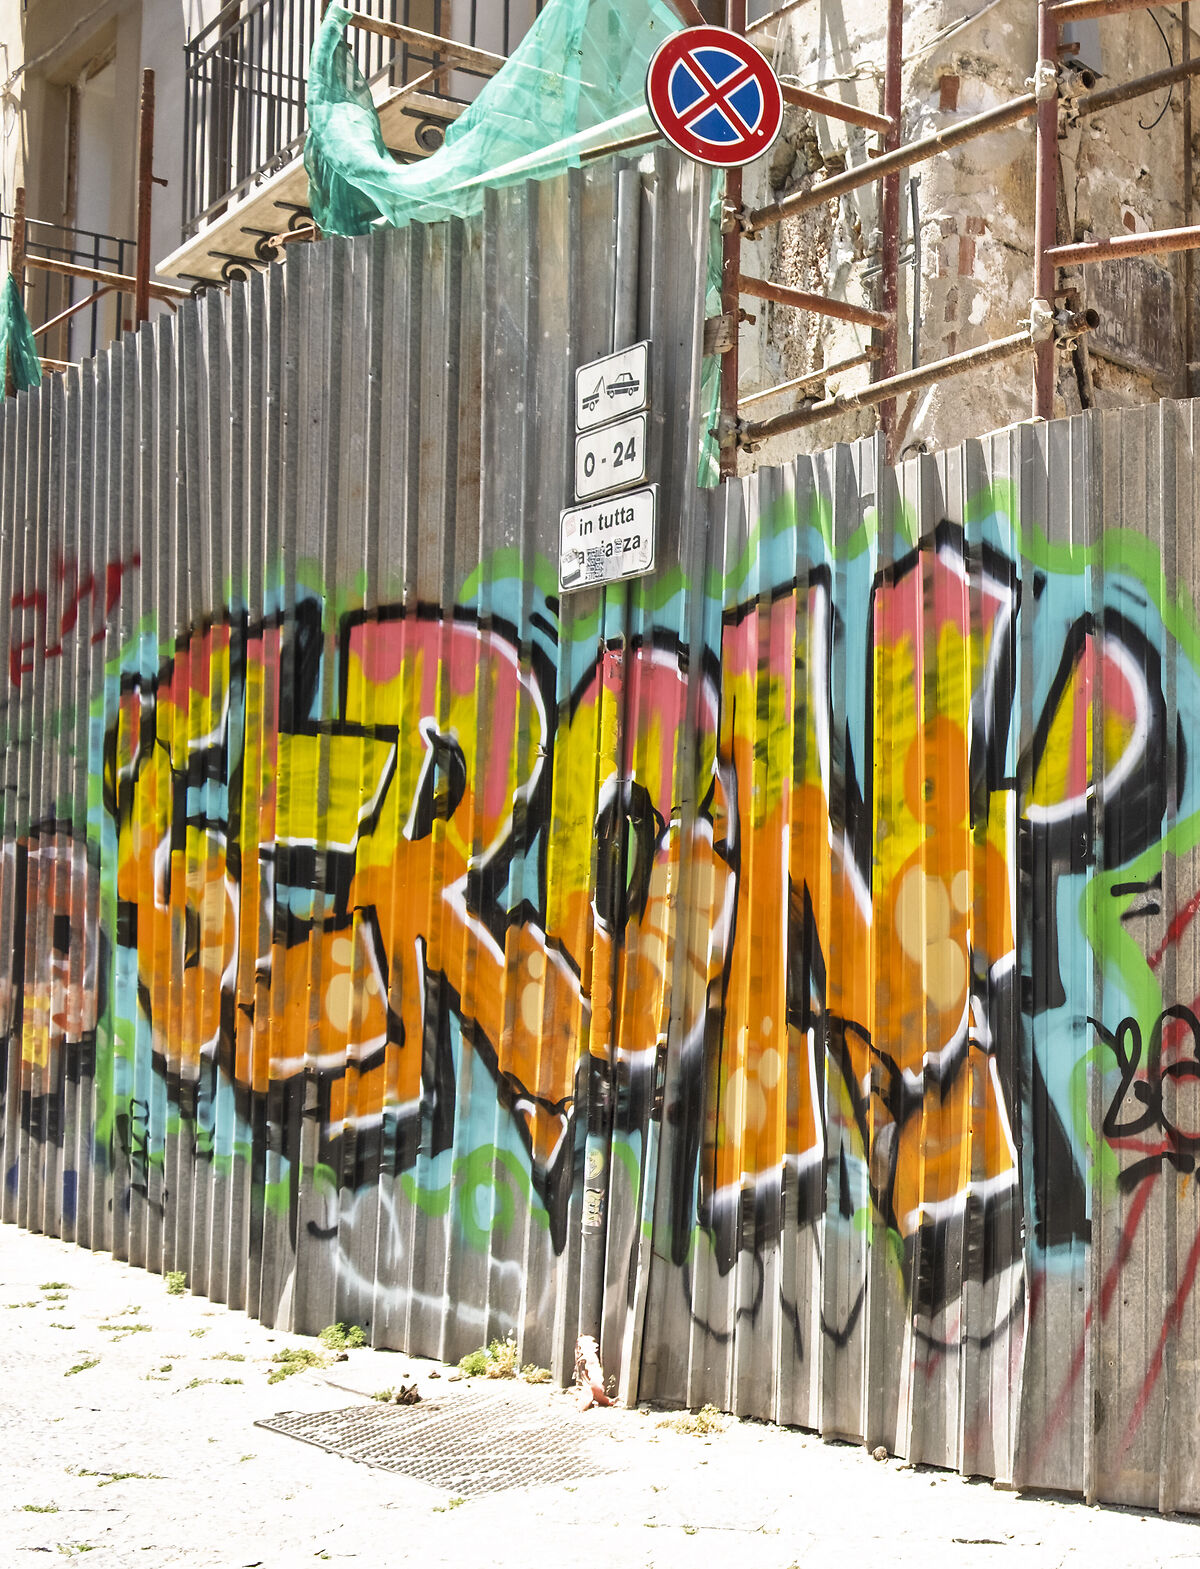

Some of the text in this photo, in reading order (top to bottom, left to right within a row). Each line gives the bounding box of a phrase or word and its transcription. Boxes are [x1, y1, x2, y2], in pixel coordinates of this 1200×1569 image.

[613, 436, 636, 468] 24
[579, 506, 635, 536] in tutta
